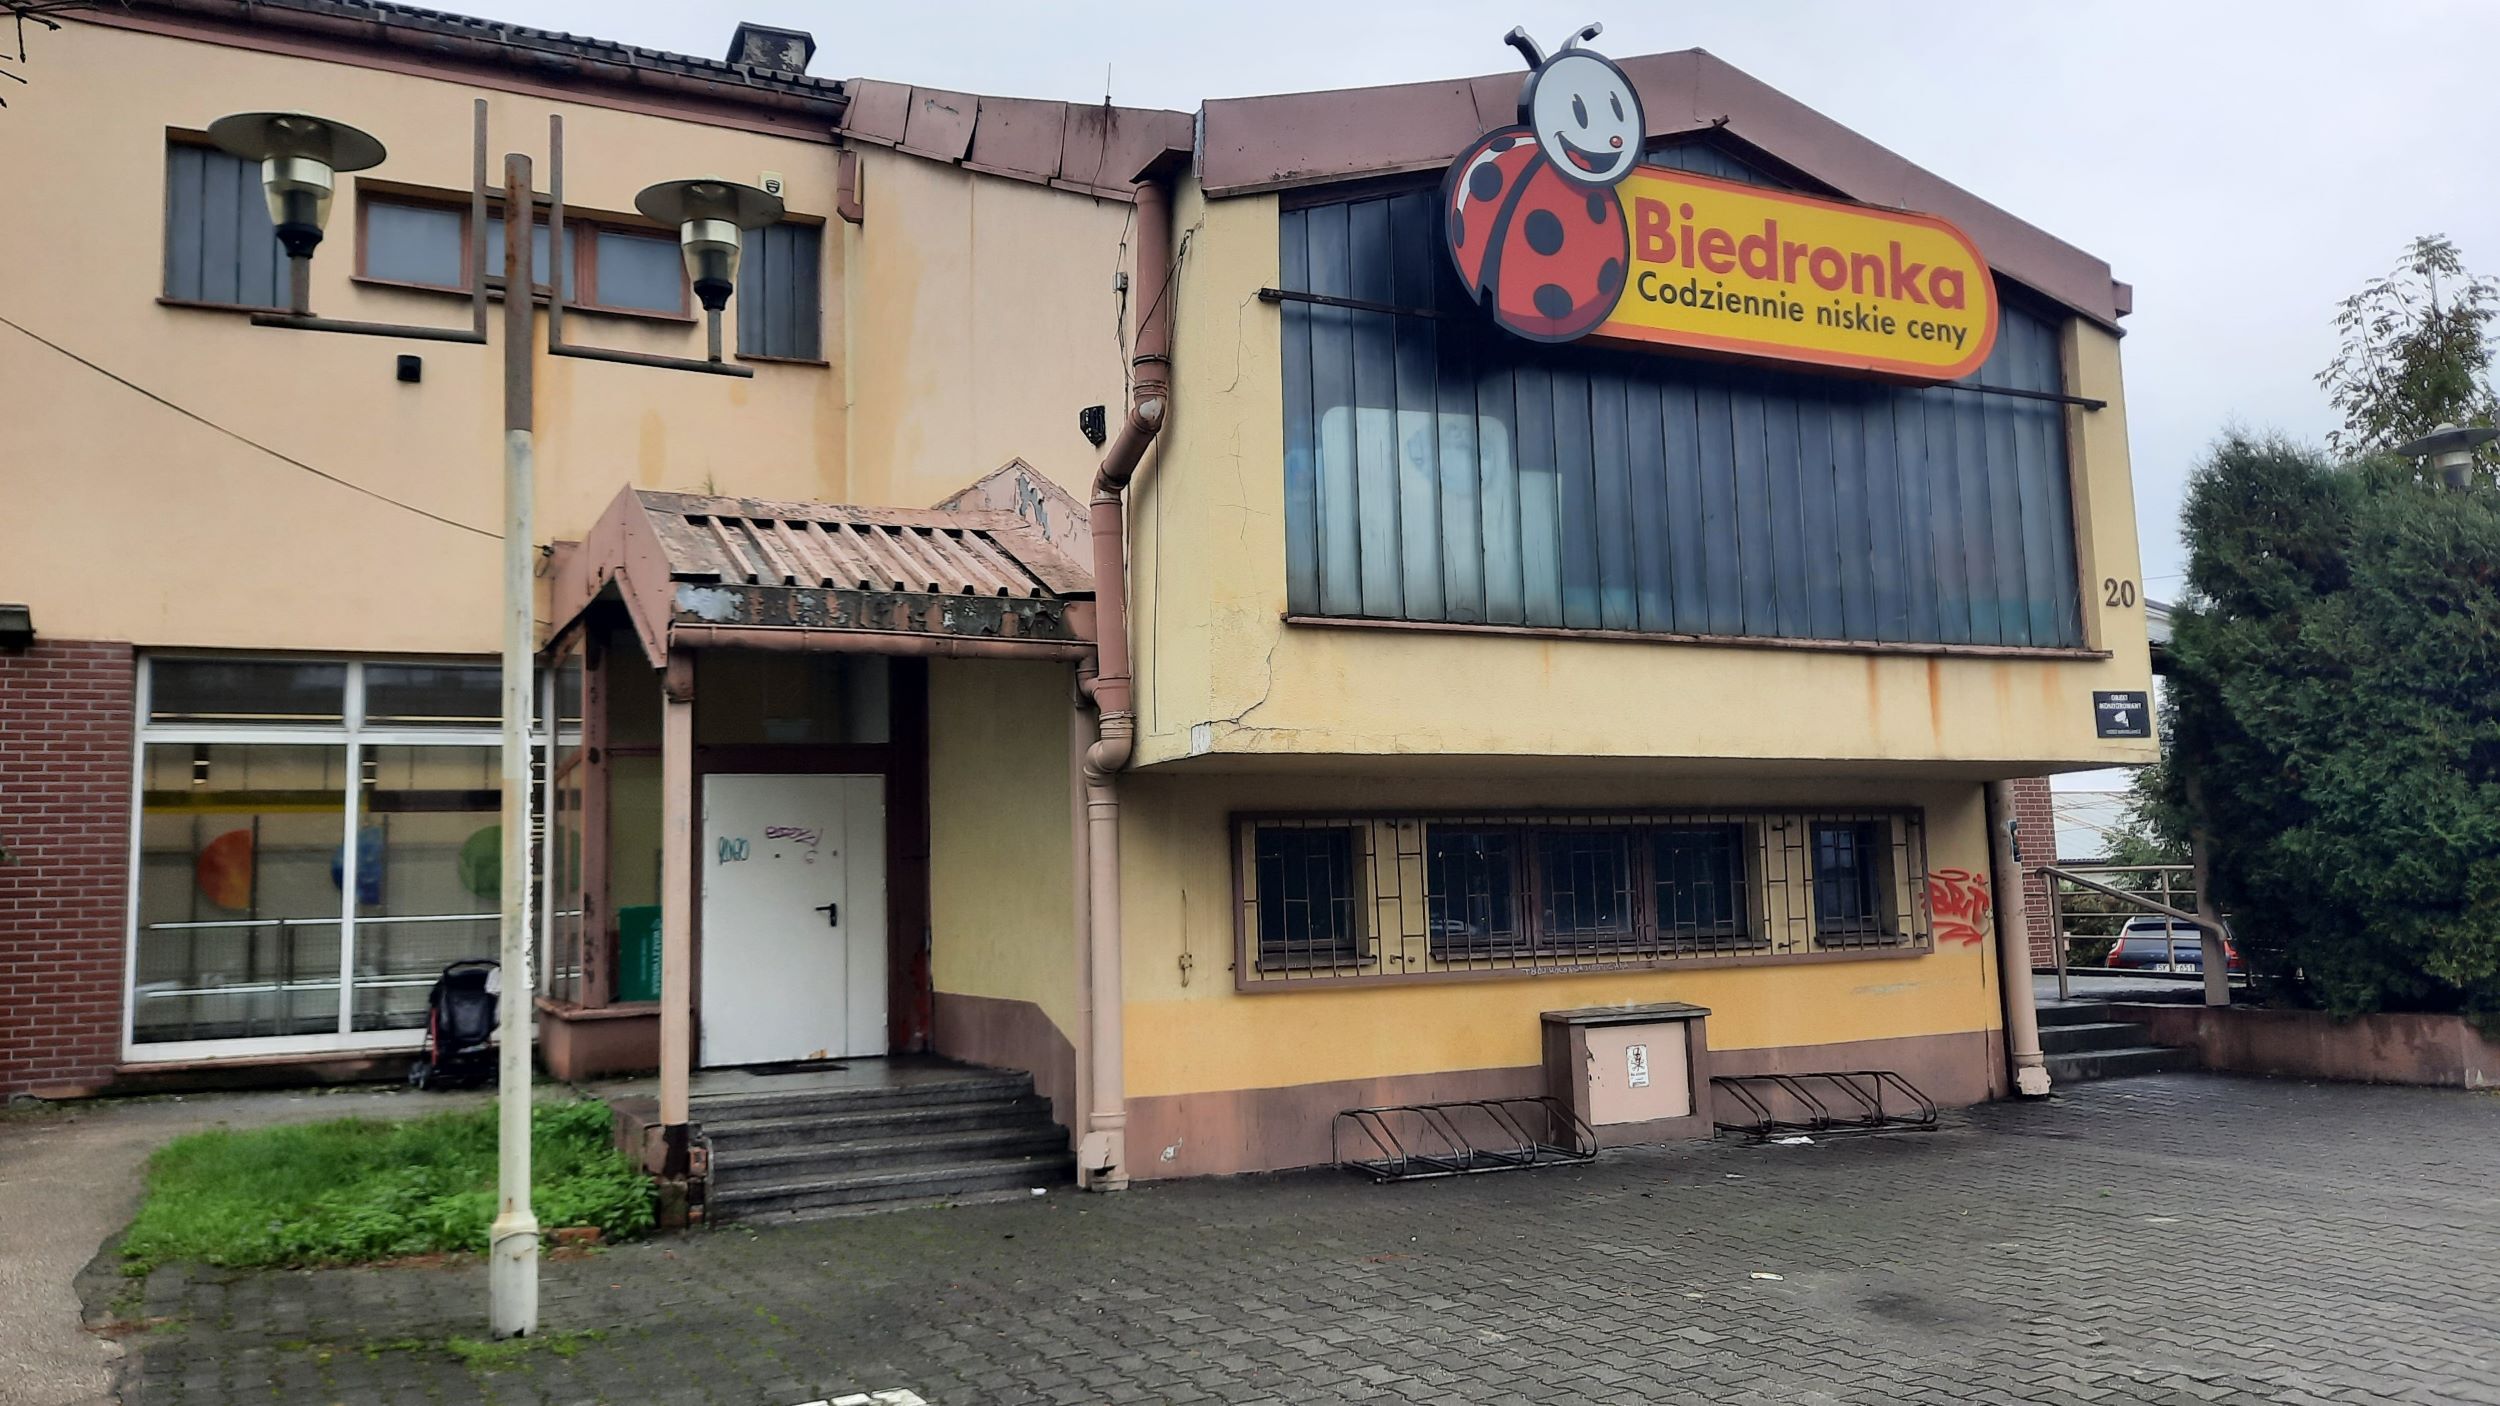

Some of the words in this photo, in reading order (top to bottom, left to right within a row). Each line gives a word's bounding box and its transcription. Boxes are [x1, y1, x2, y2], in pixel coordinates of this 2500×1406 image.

[1635, 195, 1967, 311] Biedronka
[1637, 271, 1805, 323] Codziennie
[1816, 299, 1897, 335] niskie
[1906, 318, 1968, 351] ceny
[2104, 577, 2136, 608] 20
